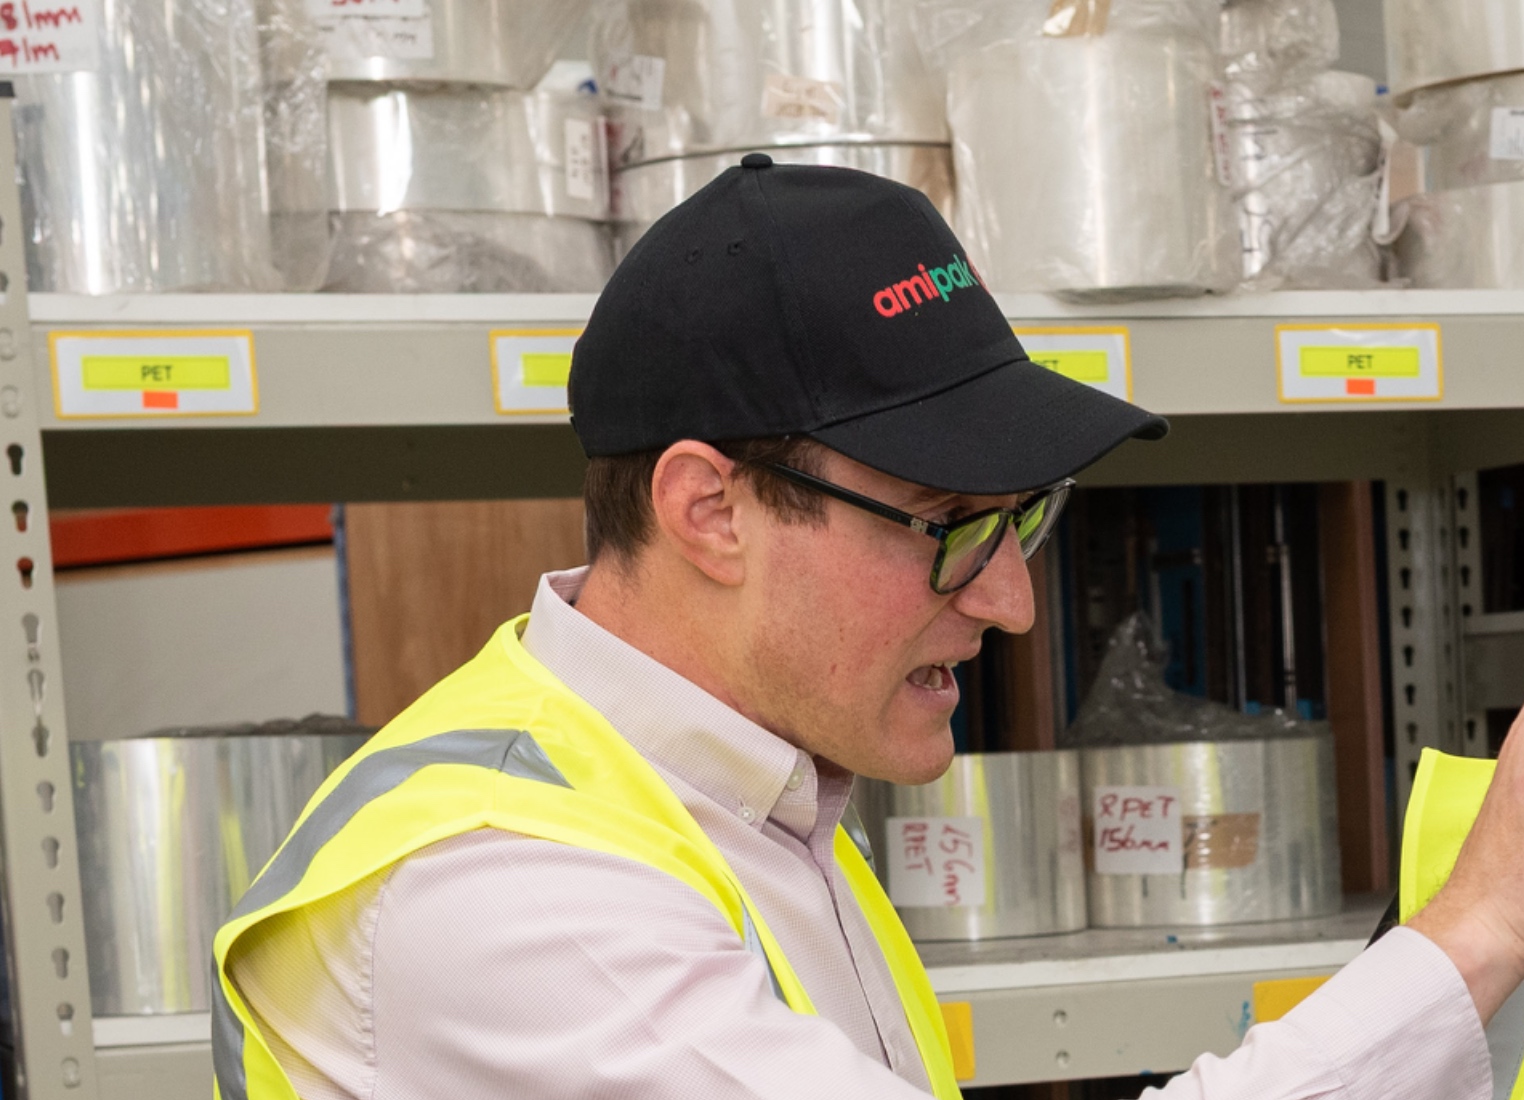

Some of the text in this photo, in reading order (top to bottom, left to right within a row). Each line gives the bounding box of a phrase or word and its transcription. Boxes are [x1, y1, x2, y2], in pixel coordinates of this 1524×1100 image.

[873, 253, 979, 318] amipak
[1347, 354, 1374, 370] PET
[141, 364, 173, 382] PET
